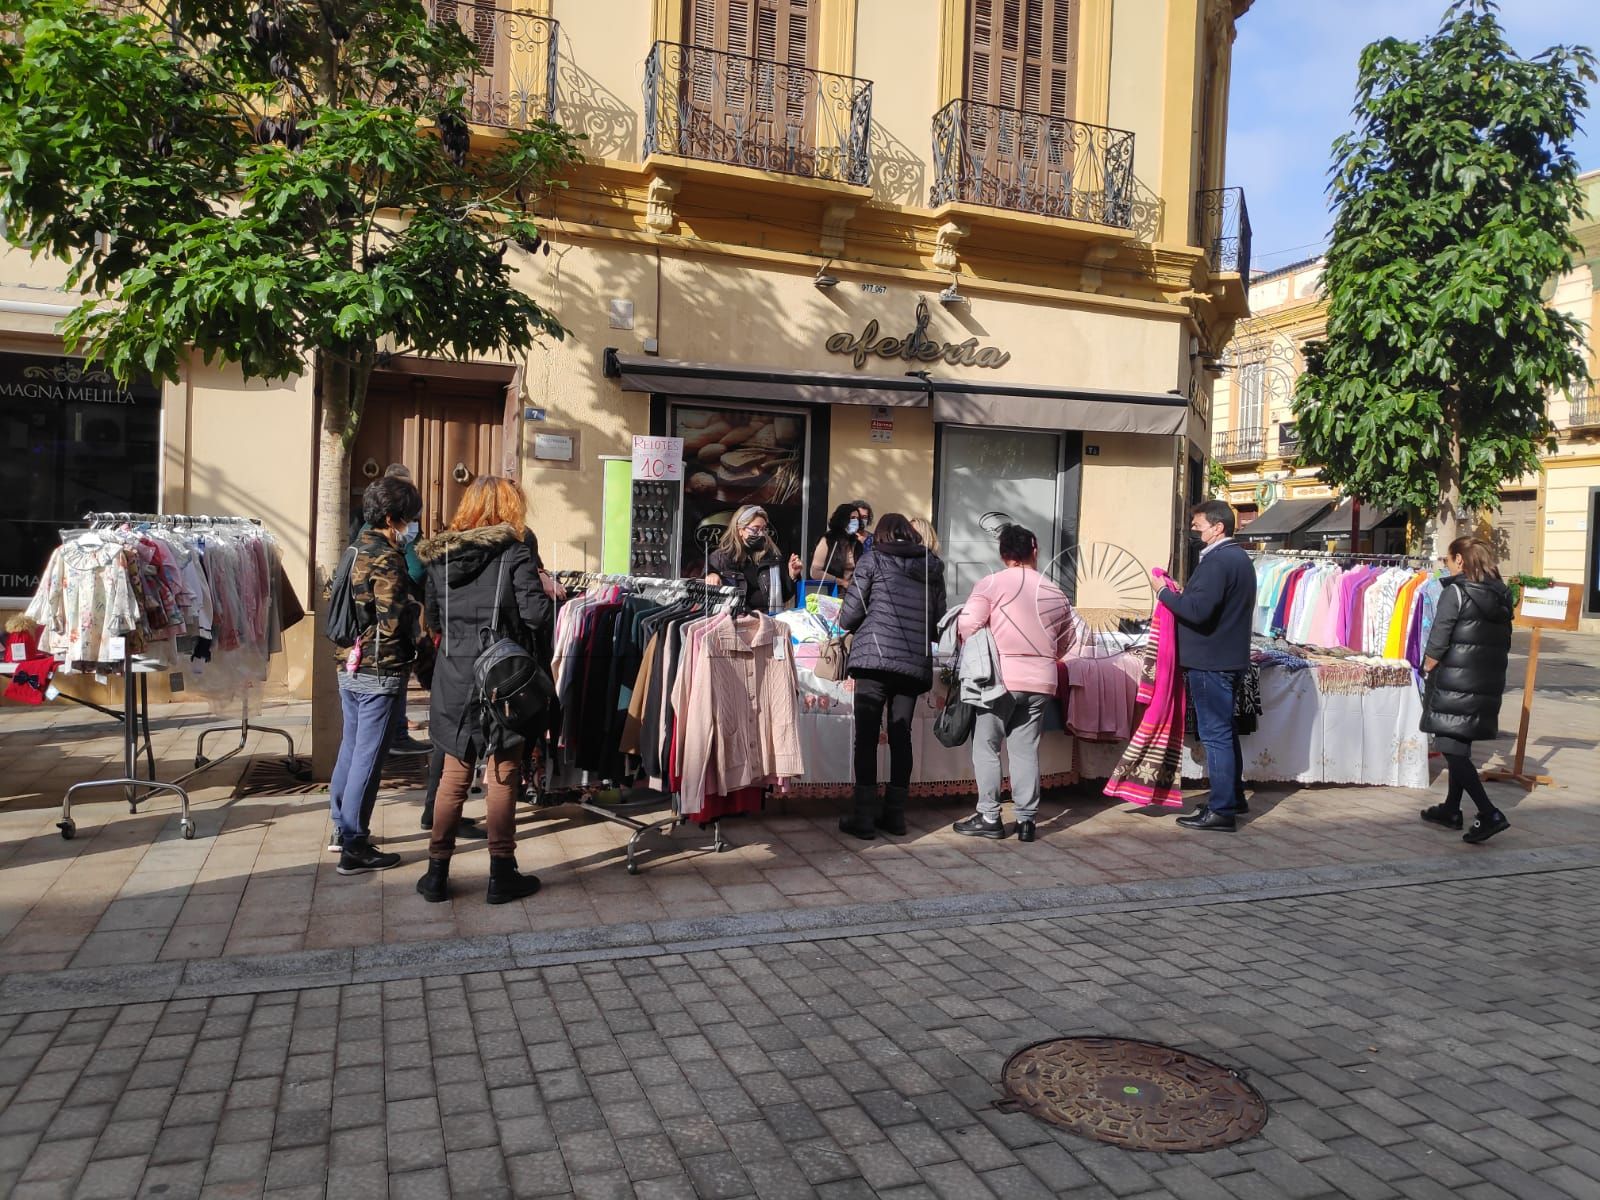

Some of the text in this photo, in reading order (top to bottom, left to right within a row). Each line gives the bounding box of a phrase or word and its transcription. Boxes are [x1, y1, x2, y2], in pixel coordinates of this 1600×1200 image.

[0, 383, 136, 404] MAGNA MELILLA
[532, 410, 538, 418] 7
